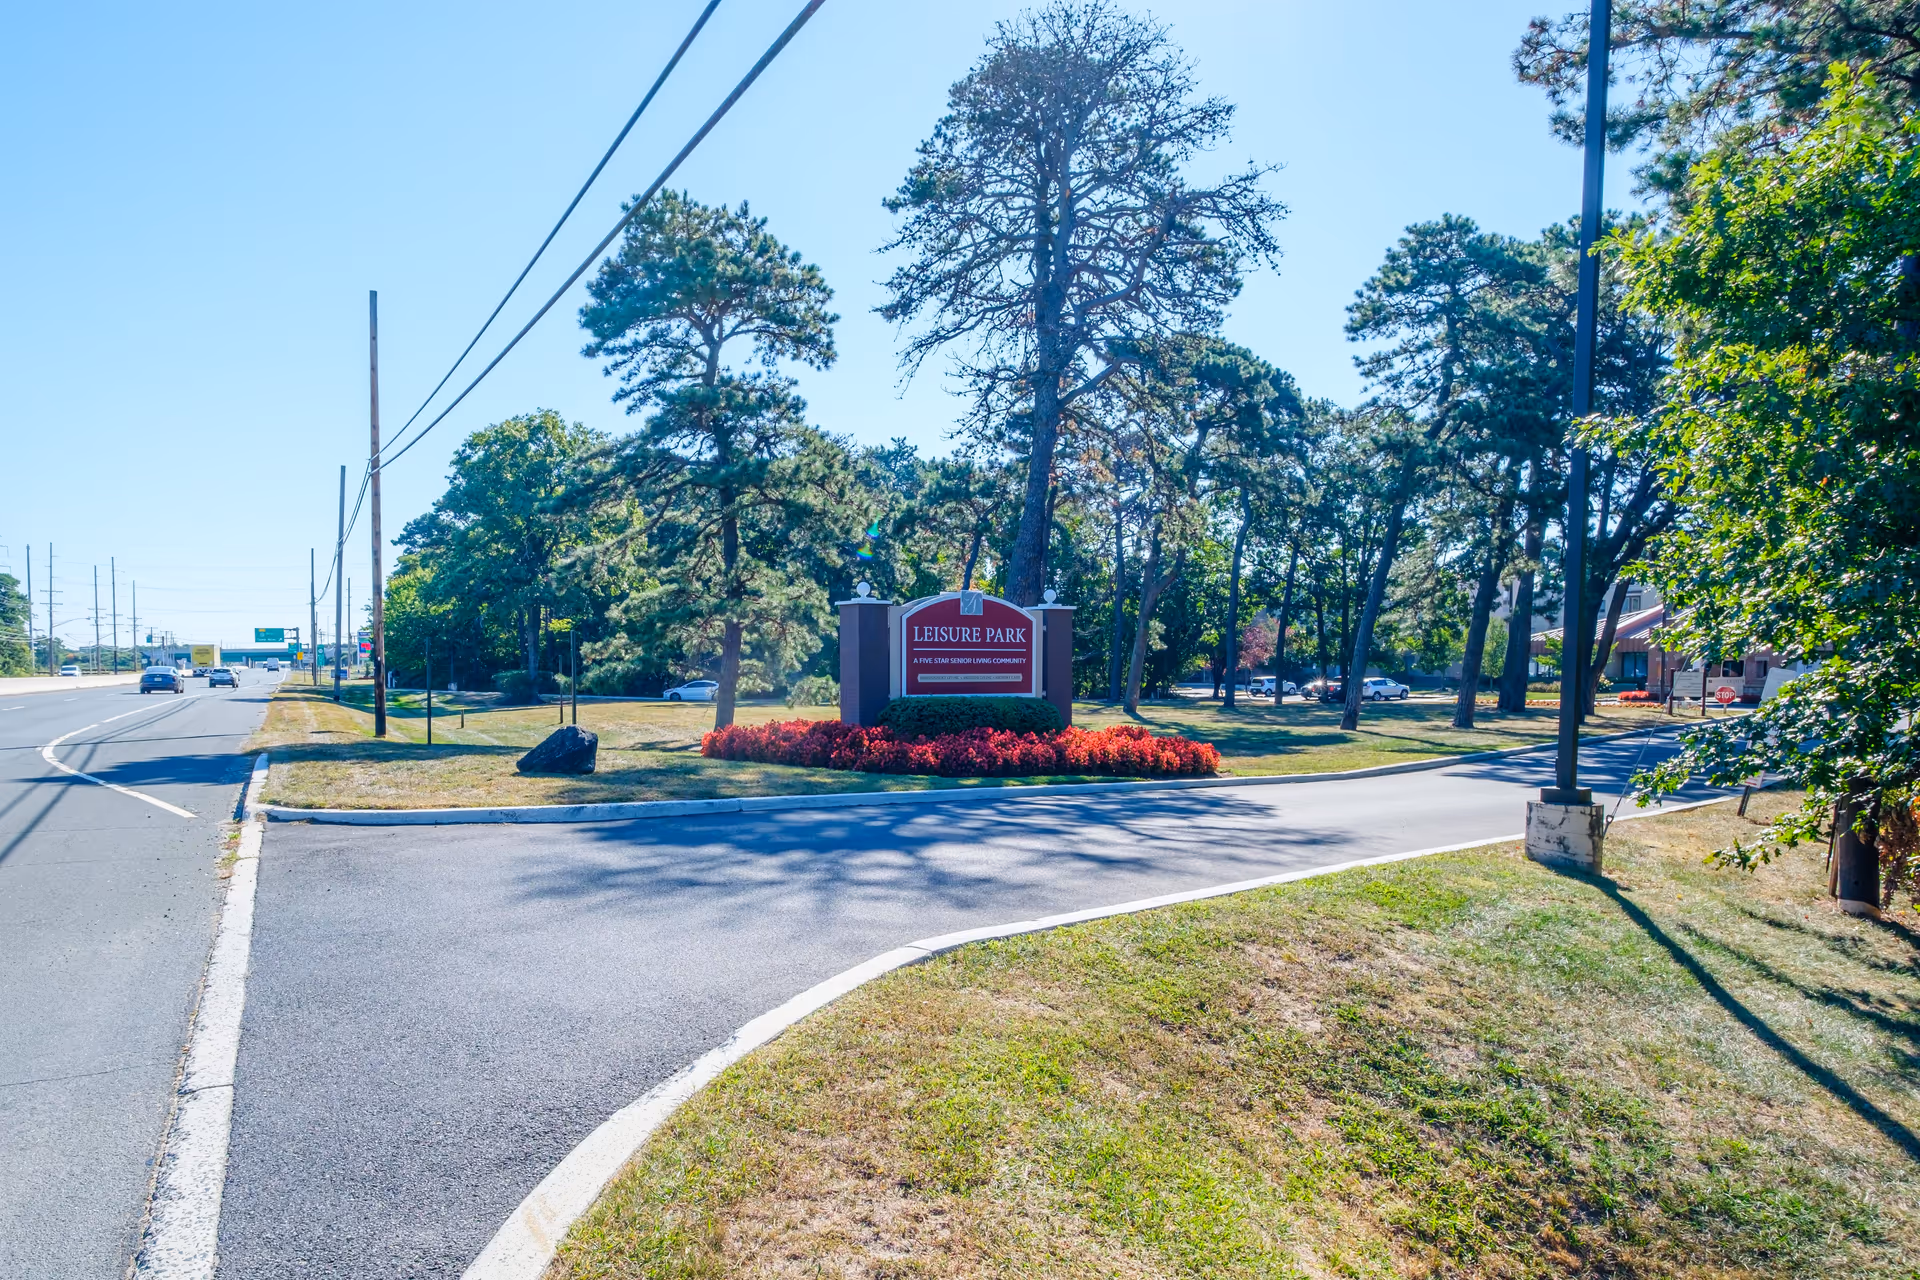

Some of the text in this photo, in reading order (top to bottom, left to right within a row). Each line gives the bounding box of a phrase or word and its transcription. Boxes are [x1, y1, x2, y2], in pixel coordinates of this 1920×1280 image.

[913, 626, 1027, 643] LEISURE PARK
[1716, 691, 1735, 699] STOP
